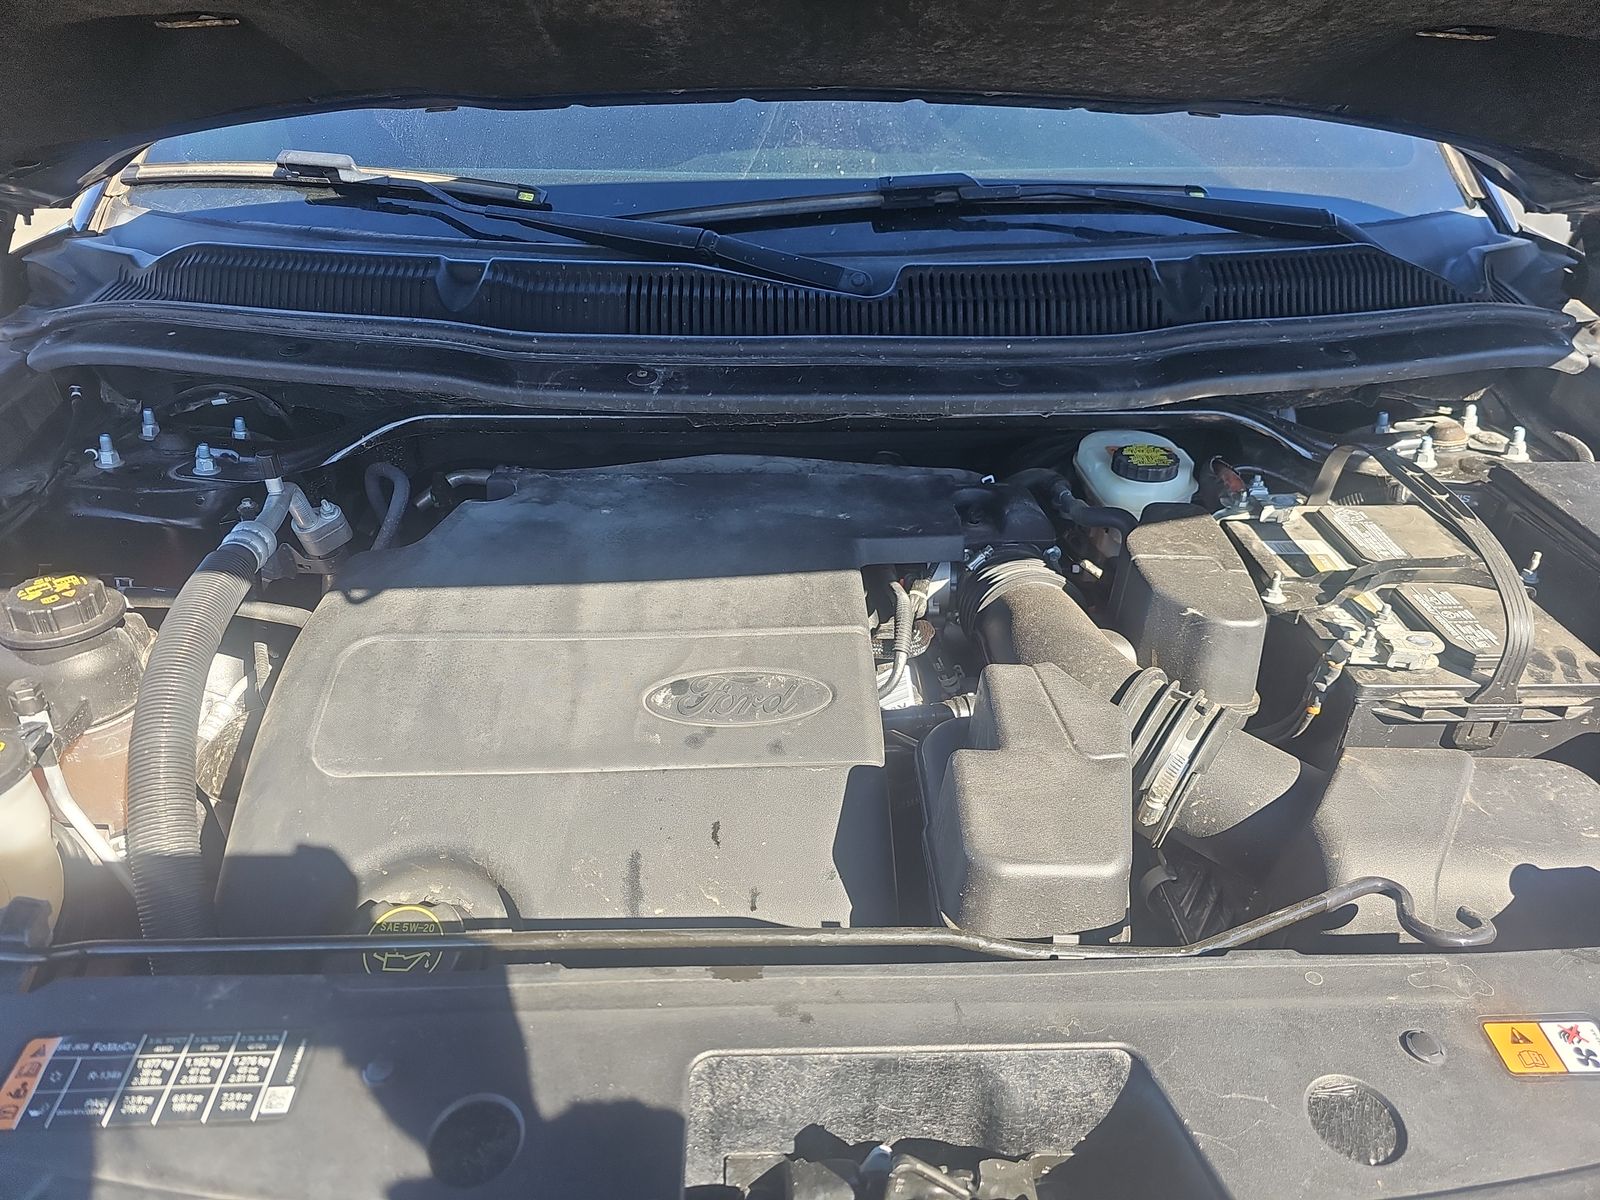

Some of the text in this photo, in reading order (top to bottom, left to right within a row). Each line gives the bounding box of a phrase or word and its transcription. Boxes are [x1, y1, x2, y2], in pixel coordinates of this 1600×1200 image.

[676, 676, 799, 717] Ford
[380, 922, 435, 933] SAE 5W-20
